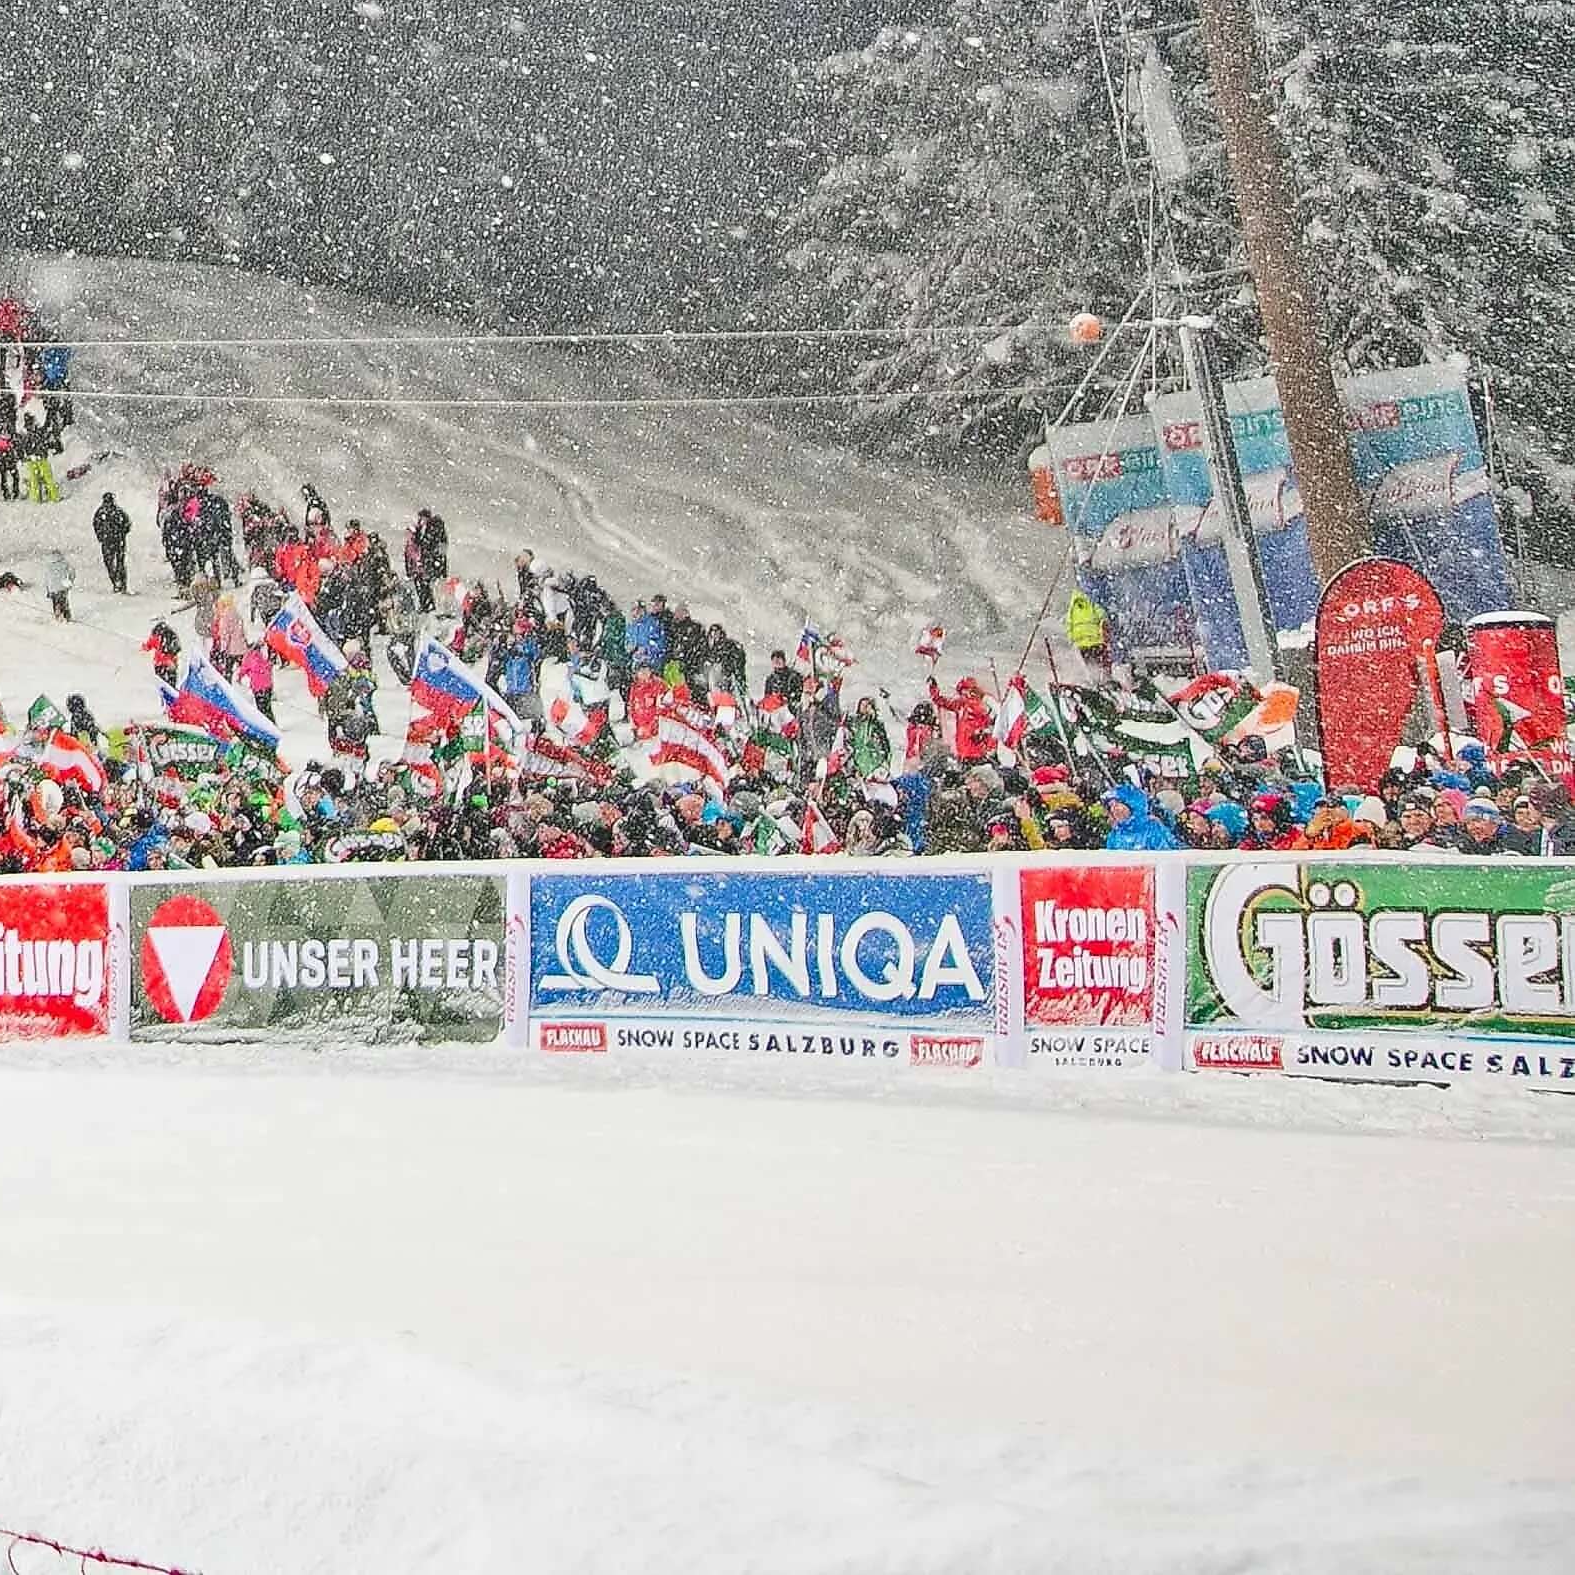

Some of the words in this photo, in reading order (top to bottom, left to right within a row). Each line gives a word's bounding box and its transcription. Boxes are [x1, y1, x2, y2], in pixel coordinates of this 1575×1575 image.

[1343, 596, 1395, 618] ORF
[1034, 899, 1146, 943] Kronen
[681, 911, 986, 1002] UNIQA
[1204, 863, 1575, 1027] Gösse
[242, 938, 380, 990] UNSER
[391, 937, 500, 989] HEER
[1036, 945, 1147, 994] Zeitung
[546, 1028, 602, 1047] FLACHAU
[618, 1029, 675, 1048] SNOW
[683, 1031, 740, 1050] SPACE
[747, 1033, 900, 1058] SALZBURG
[1030, 1037, 1086, 1054] SNOW
[1093, 1037, 1150, 1054] SPACE
[1296, 1044, 1374, 1068] SNOW
[1387, 1049, 1473, 1072] SPACE
